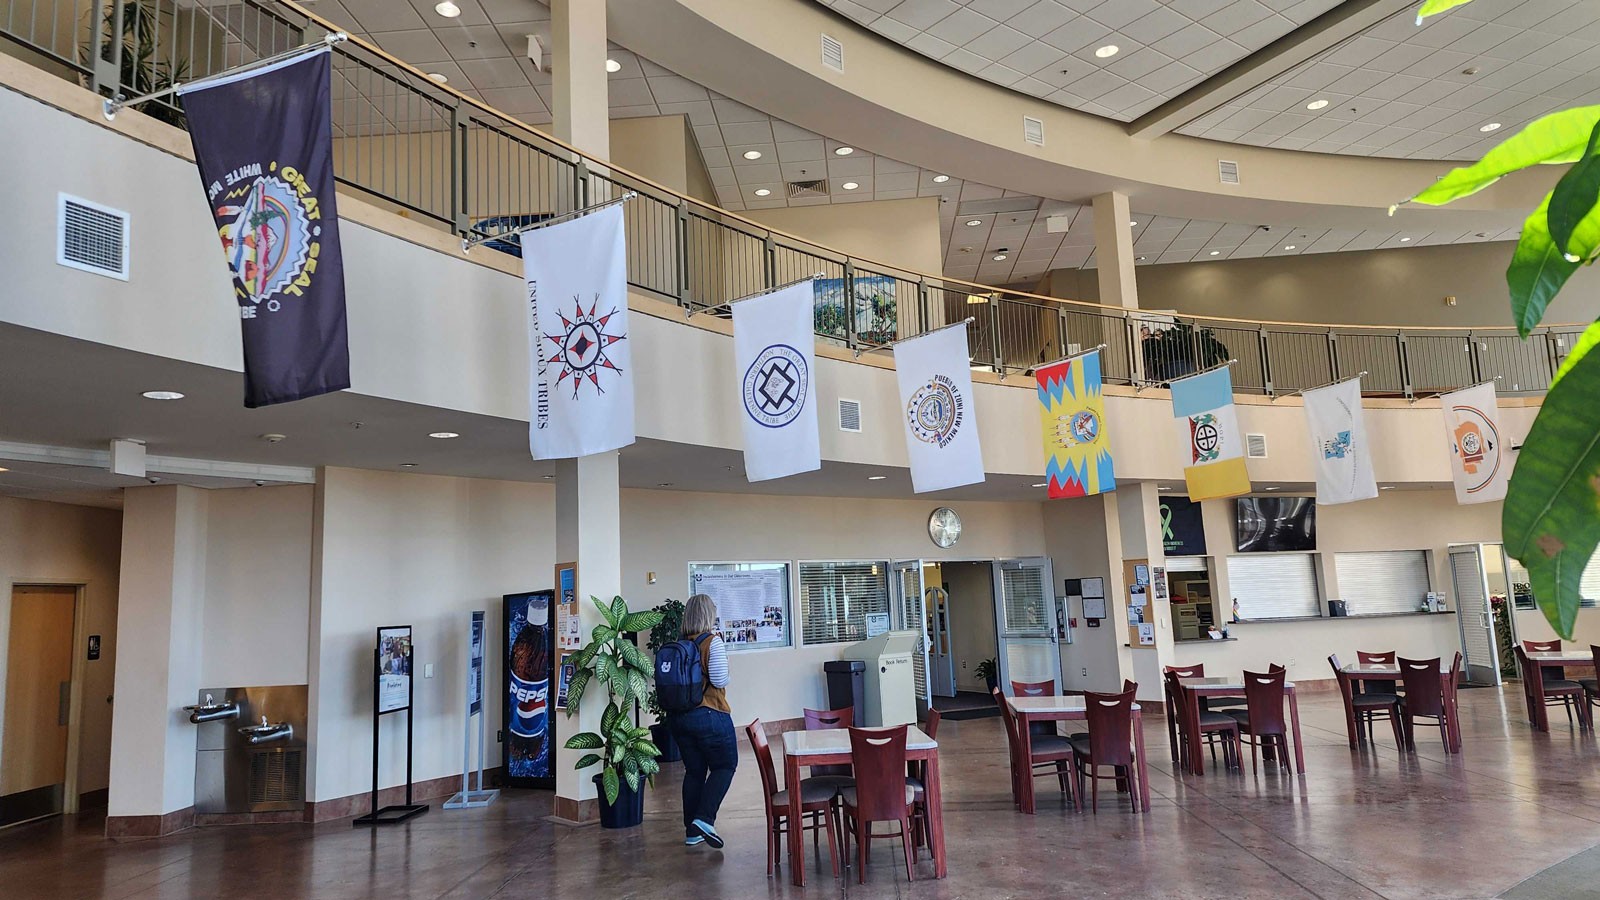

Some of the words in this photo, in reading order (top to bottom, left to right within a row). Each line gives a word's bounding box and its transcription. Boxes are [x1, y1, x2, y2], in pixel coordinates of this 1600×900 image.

[224, 162, 262, 186] WHITE
[280, 166, 320, 220] GREAT
[283, 242, 320, 296] SEAL
[528, 280, 539, 331] UNITED
[536, 335, 547, 376] SIOUX
[780, 348, 792, 357] THE
[792, 355, 806, 376] GREAT
[538, 380, 549, 430] TRIBES
[746, 382, 761, 418] CHEYENNE
[762, 415, 780, 424] TRIBE
[950, 385, 959, 394] OF
[954, 394, 963, 410] ZUNI
[954, 411, 963, 428] NEW
[939, 428, 958, 449] MEXICO
